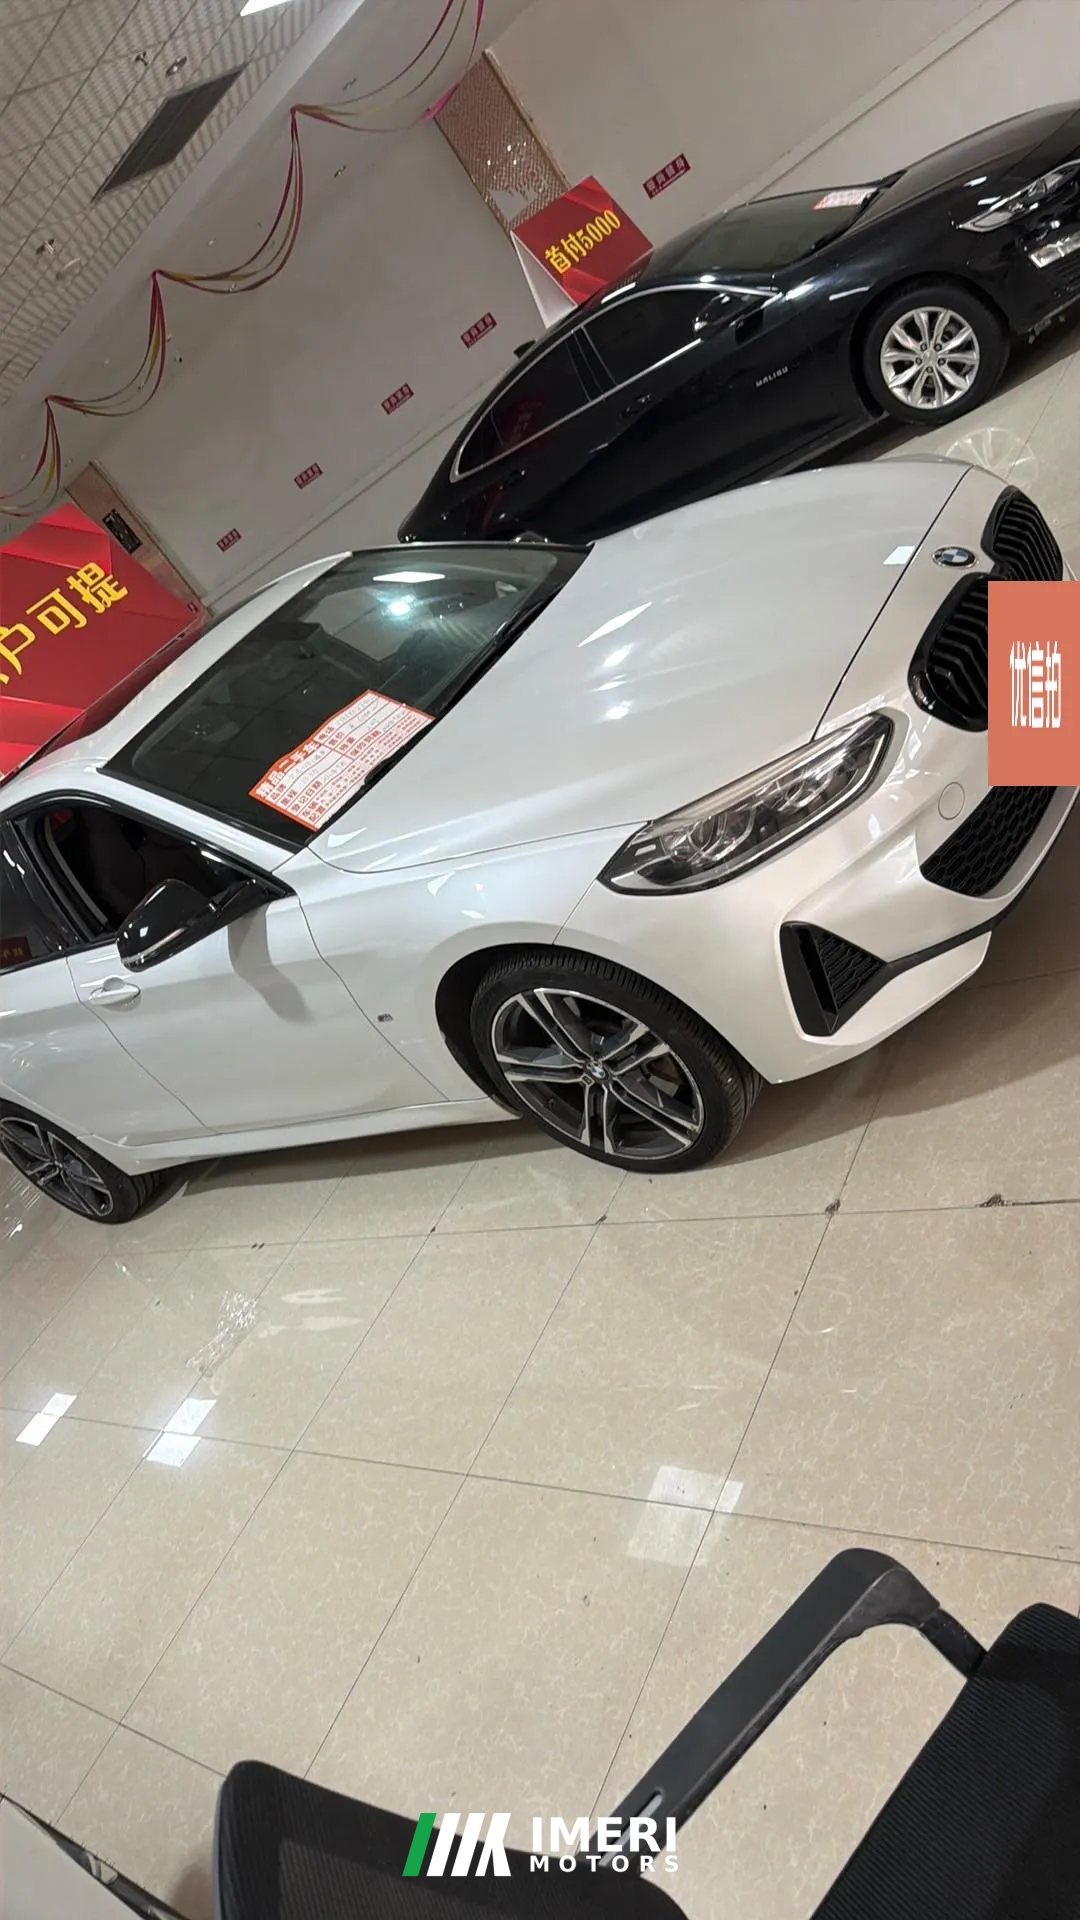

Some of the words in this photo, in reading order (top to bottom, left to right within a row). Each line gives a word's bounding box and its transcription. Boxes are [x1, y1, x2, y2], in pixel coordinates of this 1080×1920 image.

[545, 209, 621, 273] 首付5000
[0, 562, 128, 684] 户可提
[256, 741, 320, 798] 精品二手车
